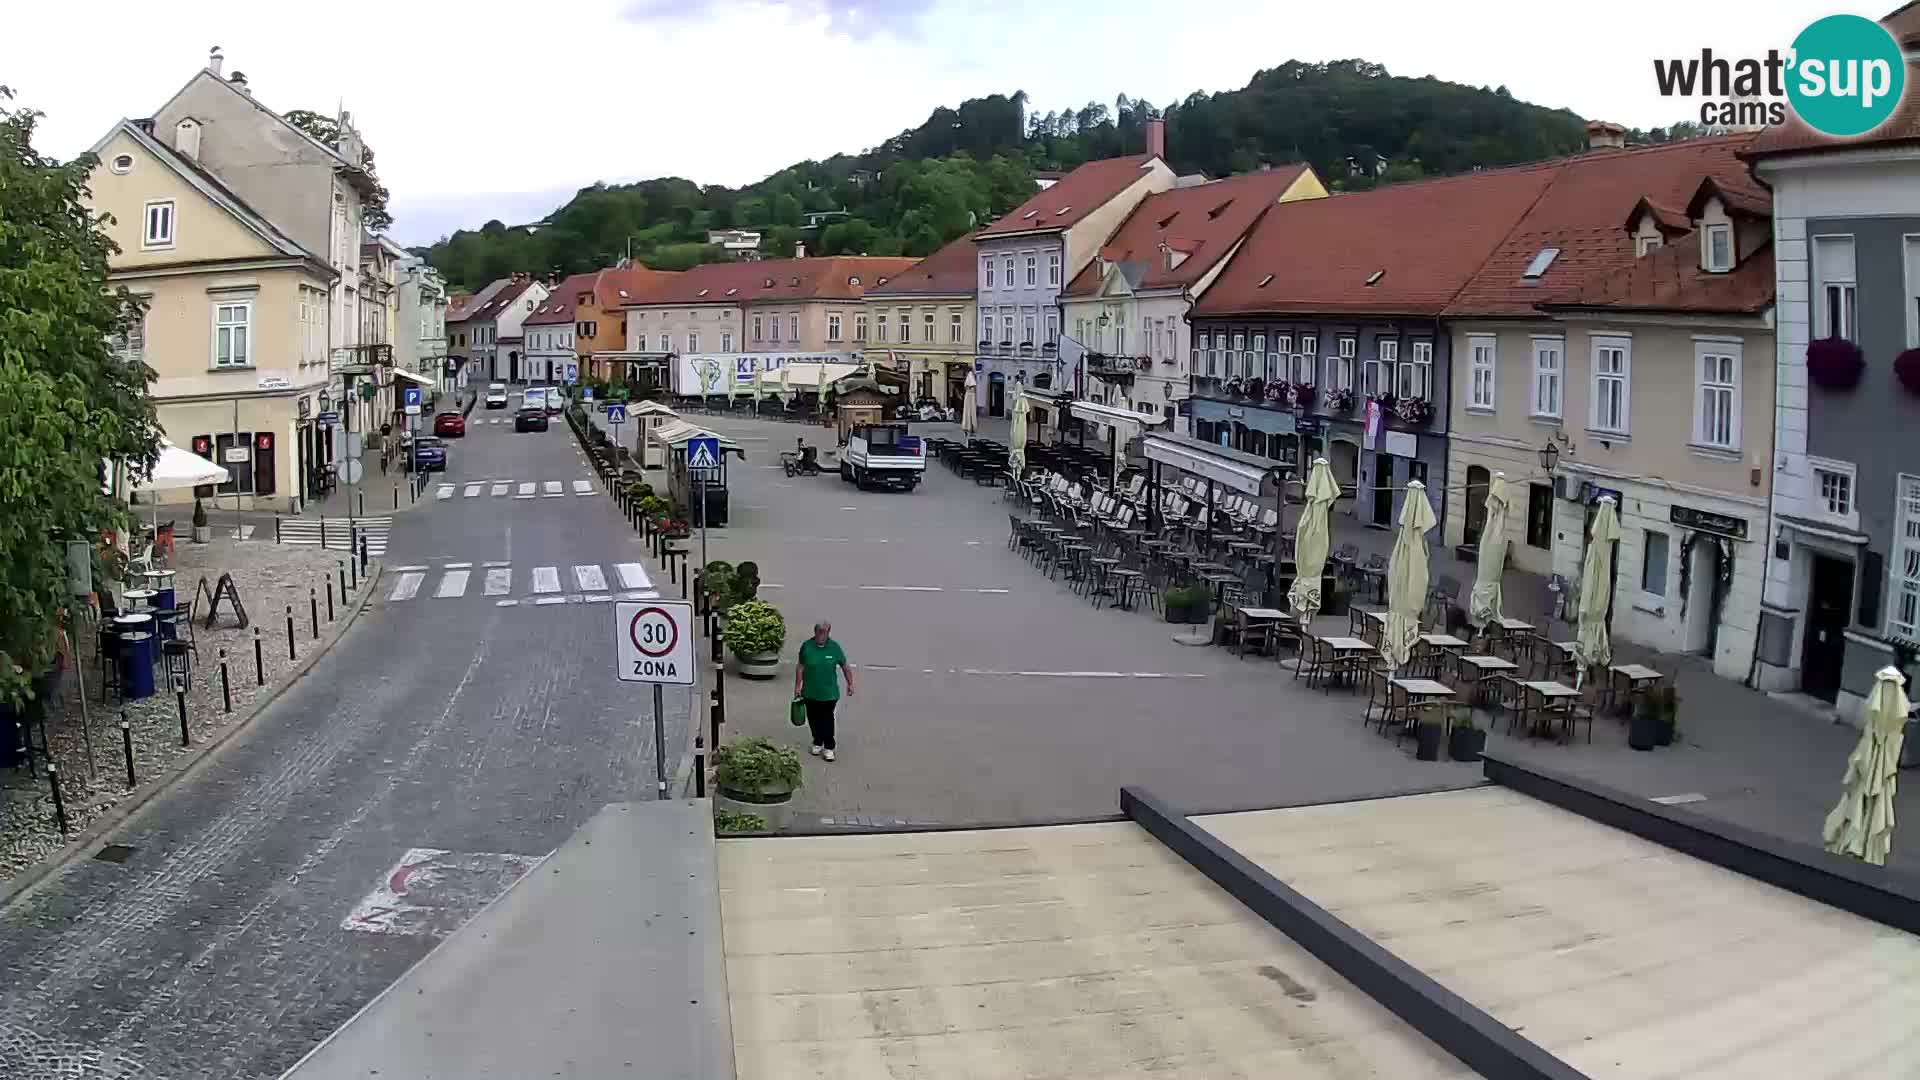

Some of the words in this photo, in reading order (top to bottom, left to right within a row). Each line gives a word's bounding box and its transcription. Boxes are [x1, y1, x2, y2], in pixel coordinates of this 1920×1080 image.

[409, 391, 417, 403] P
[643, 623, 666, 644] 30
[633, 661, 677, 677] ZONA
